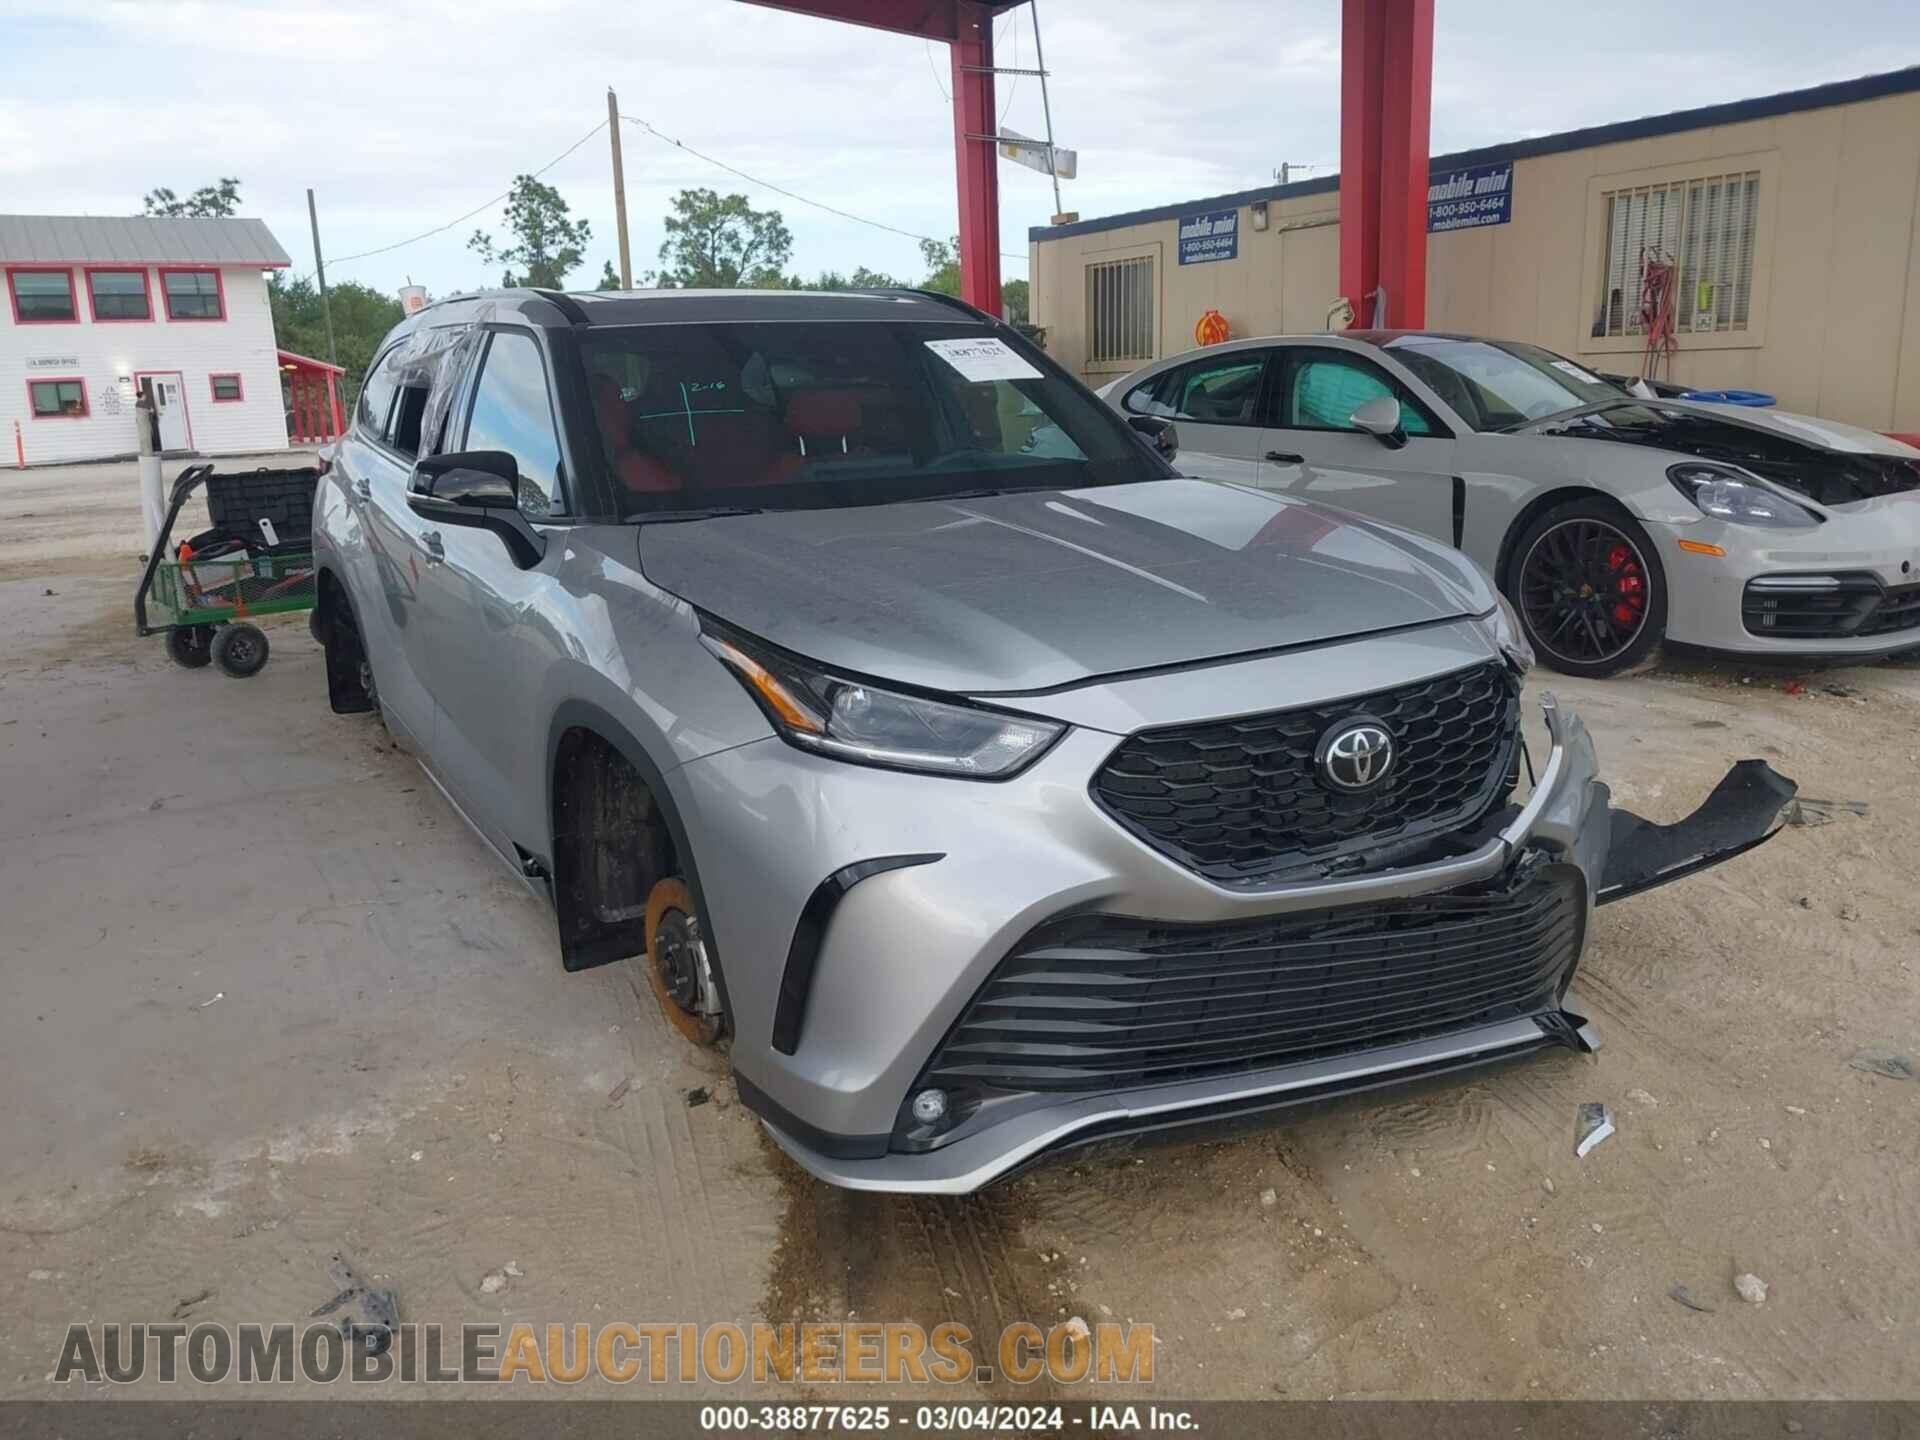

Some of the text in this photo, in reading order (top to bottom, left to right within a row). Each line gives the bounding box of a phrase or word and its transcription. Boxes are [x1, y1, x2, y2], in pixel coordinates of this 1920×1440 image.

[1428, 168, 1511, 201] mobile mini
[1429, 196, 1505, 218] 1-800-950-6464
[1180, 214, 1237, 240] mobile mini
[1432, 214, 1500, 232] mobilemini.com
